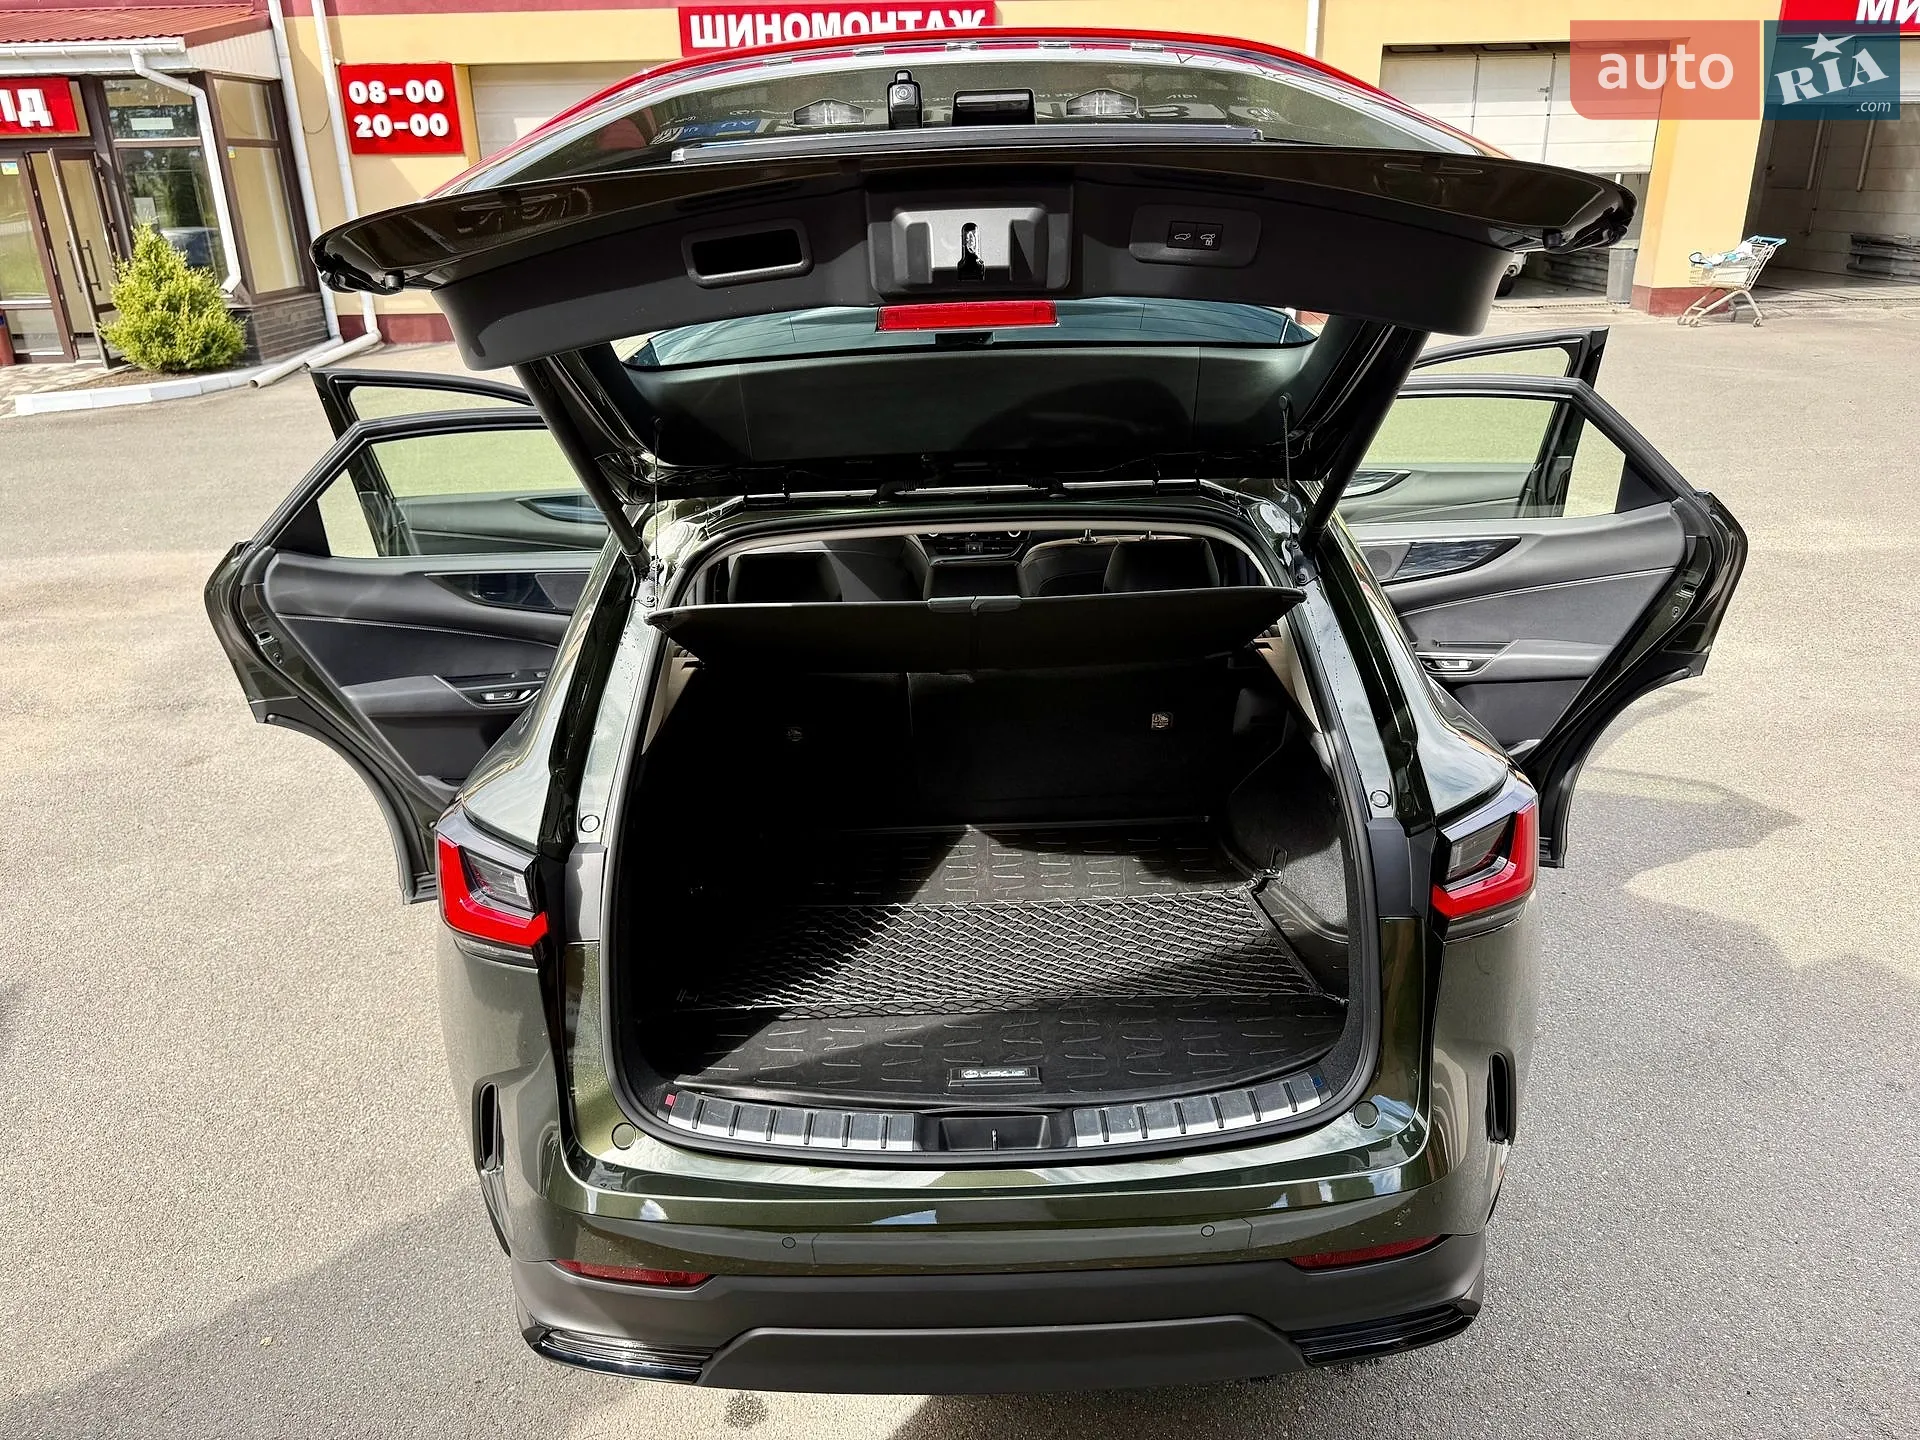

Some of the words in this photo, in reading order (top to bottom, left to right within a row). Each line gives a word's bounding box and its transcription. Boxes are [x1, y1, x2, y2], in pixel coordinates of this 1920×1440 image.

[690, 9, 986, 48] ШИНОМОНТАЖ
[348, 79, 445, 105] 08-00
[353, 113, 450, 138] 20-00
